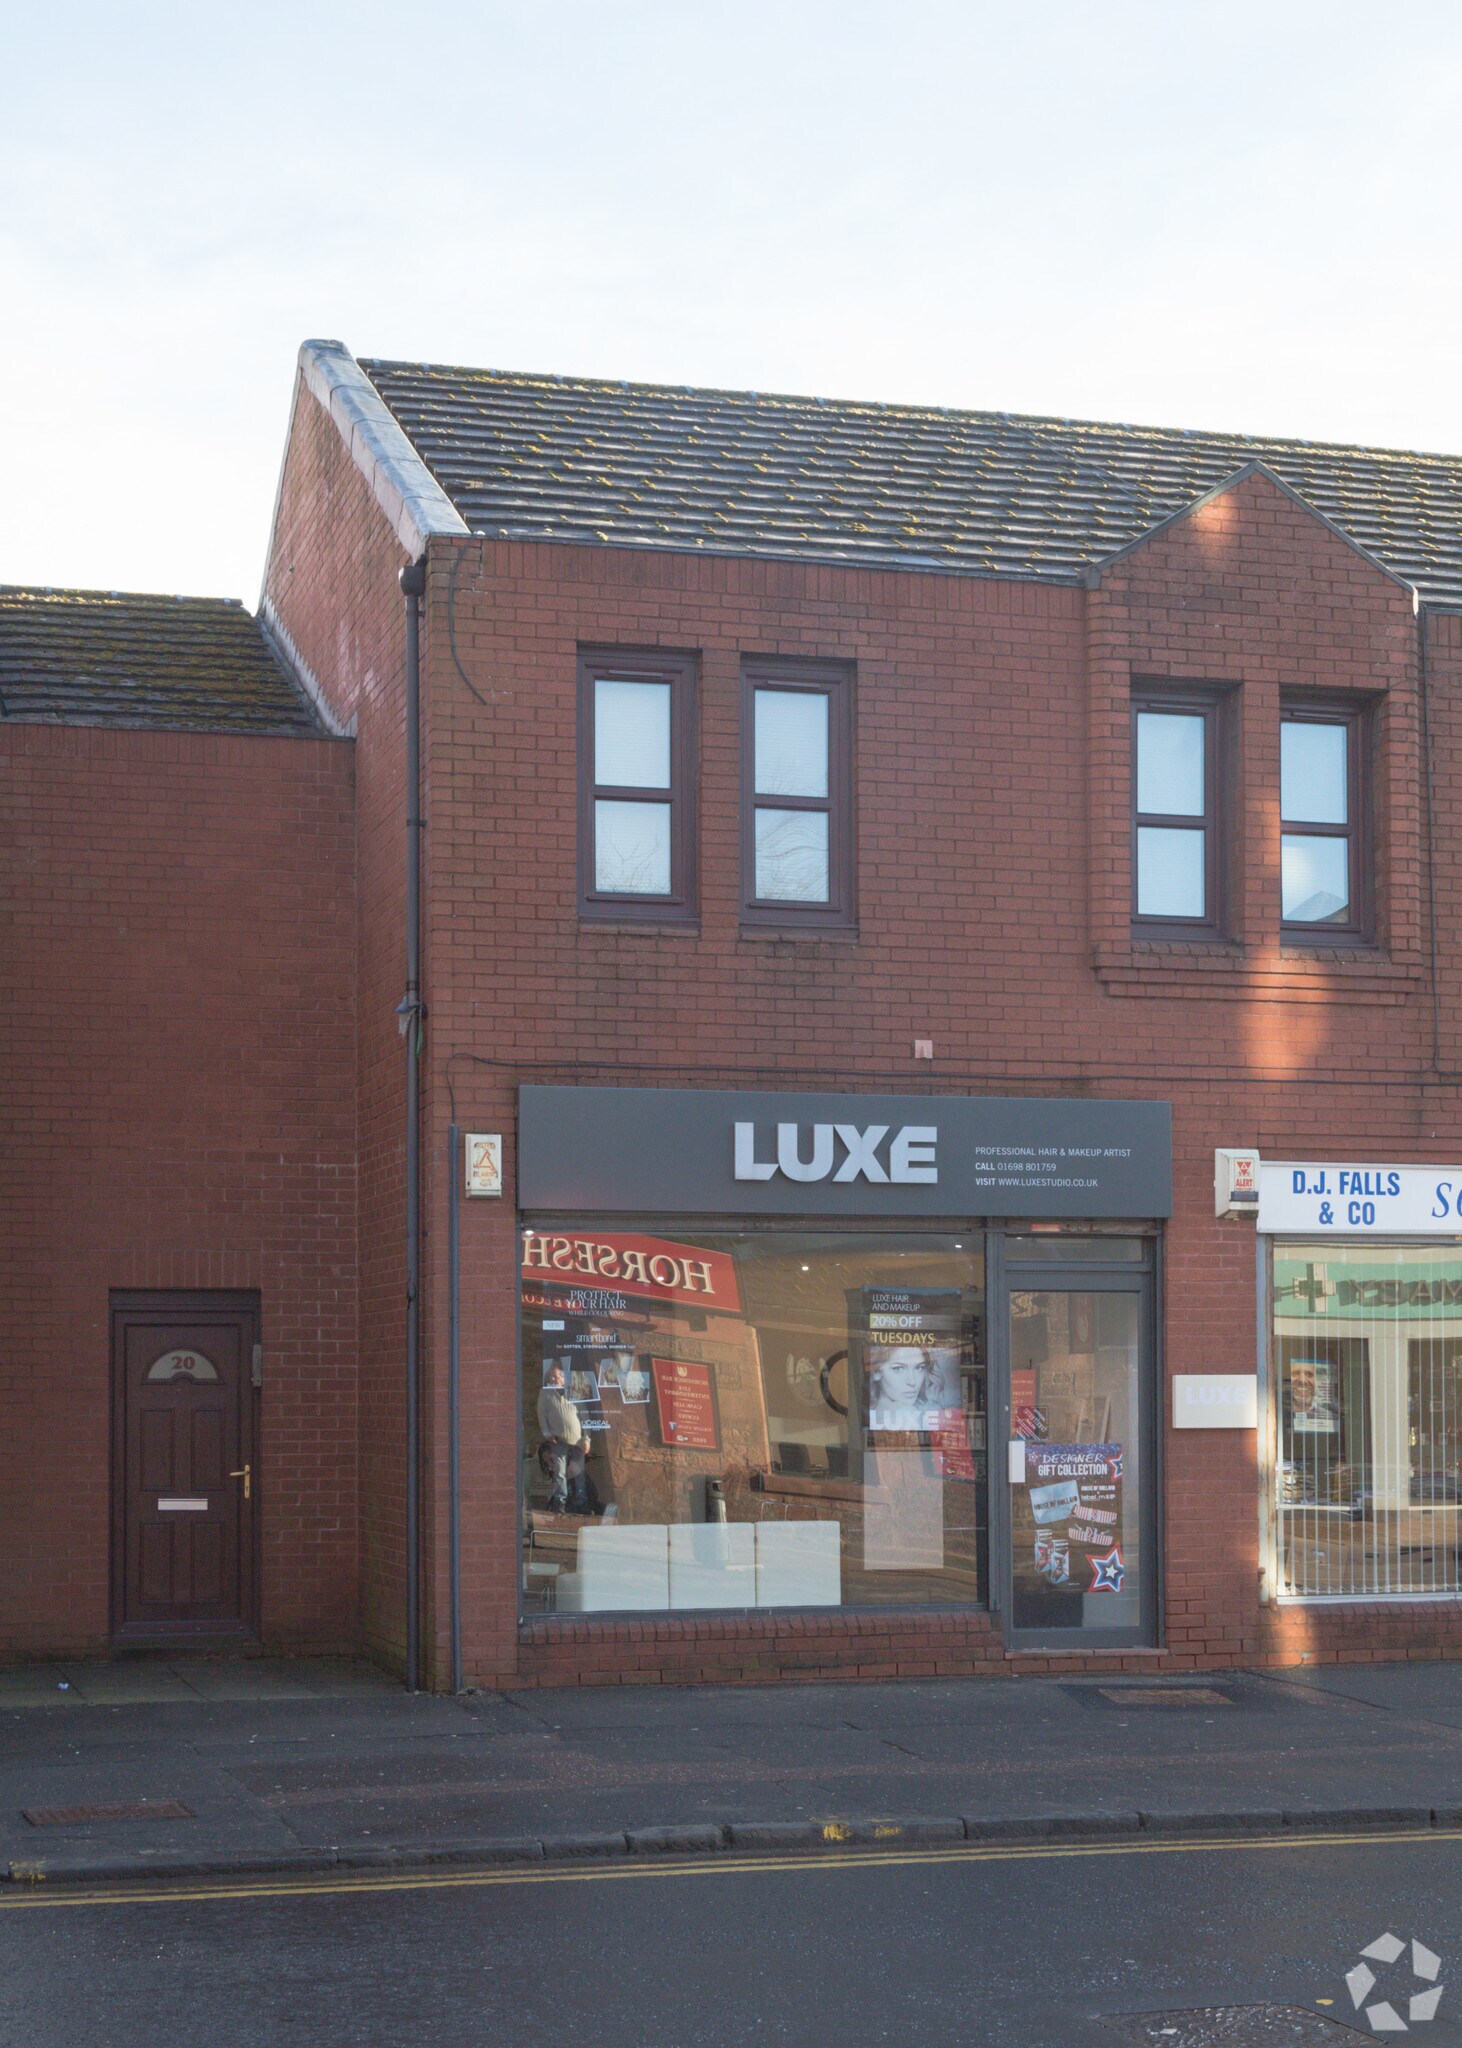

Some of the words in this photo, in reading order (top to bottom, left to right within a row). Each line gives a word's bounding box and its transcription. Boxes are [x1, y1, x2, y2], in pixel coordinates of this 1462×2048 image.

[735, 1122, 938, 1184] LUXE
[975, 1147, 1036, 1156] PROFESSIONAL
[1038, 1147, 1058, 1156] HAIR
[1060, 1148, 1066, 1156] &
[1068, 1148, 1101, 1157] MAKEUP
[1104, 1148, 1132, 1157] ARTIST
[975, 1163, 995, 1171] CALL
[997, 1163, 1024, 1171] 01698
[1025, 1163, 1057, 1172] 801759
[975, 1178, 996, 1186] VISIT
[998, 1178, 1099, 1187] WWW.LUXESTUDIO.CO.UK
[1292, 1170, 1331, 1194] D.J.
[1339, 1171, 1400, 1196] FALLS
[1319, 1201, 1334, 1225] &
[1348, 1201, 1375, 1225] CO
[570, 1290, 622, 1300] PROTECT
[872, 1294, 891, 1302] LUXE
[892, 1294, 909, 1302] HAIR
[566, 1300, 599, 1309] YOUR
[599, 1299, 627, 1309] HAIR
[872, 1303, 889, 1311] AND
[889, 1303, 920, 1312] MAKEUP
[872, 1315, 897, 1327] 20%
[899, 1316, 922, 1327] OFF
[576, 1333, 616, 1343] smartbond
[871, 1331, 935, 1344] TUESDAYS
[171, 1356, 195, 1370] 20
[1185, 1386, 1248, 1405] LUXE
[870, 1410, 939, 1430] LUXE
[1043, 1453, 1104, 1464] DESIGNER
[1038, 1464, 1056, 1476] GIFT
[1057, 1463, 1108, 1475] COLLECTION
